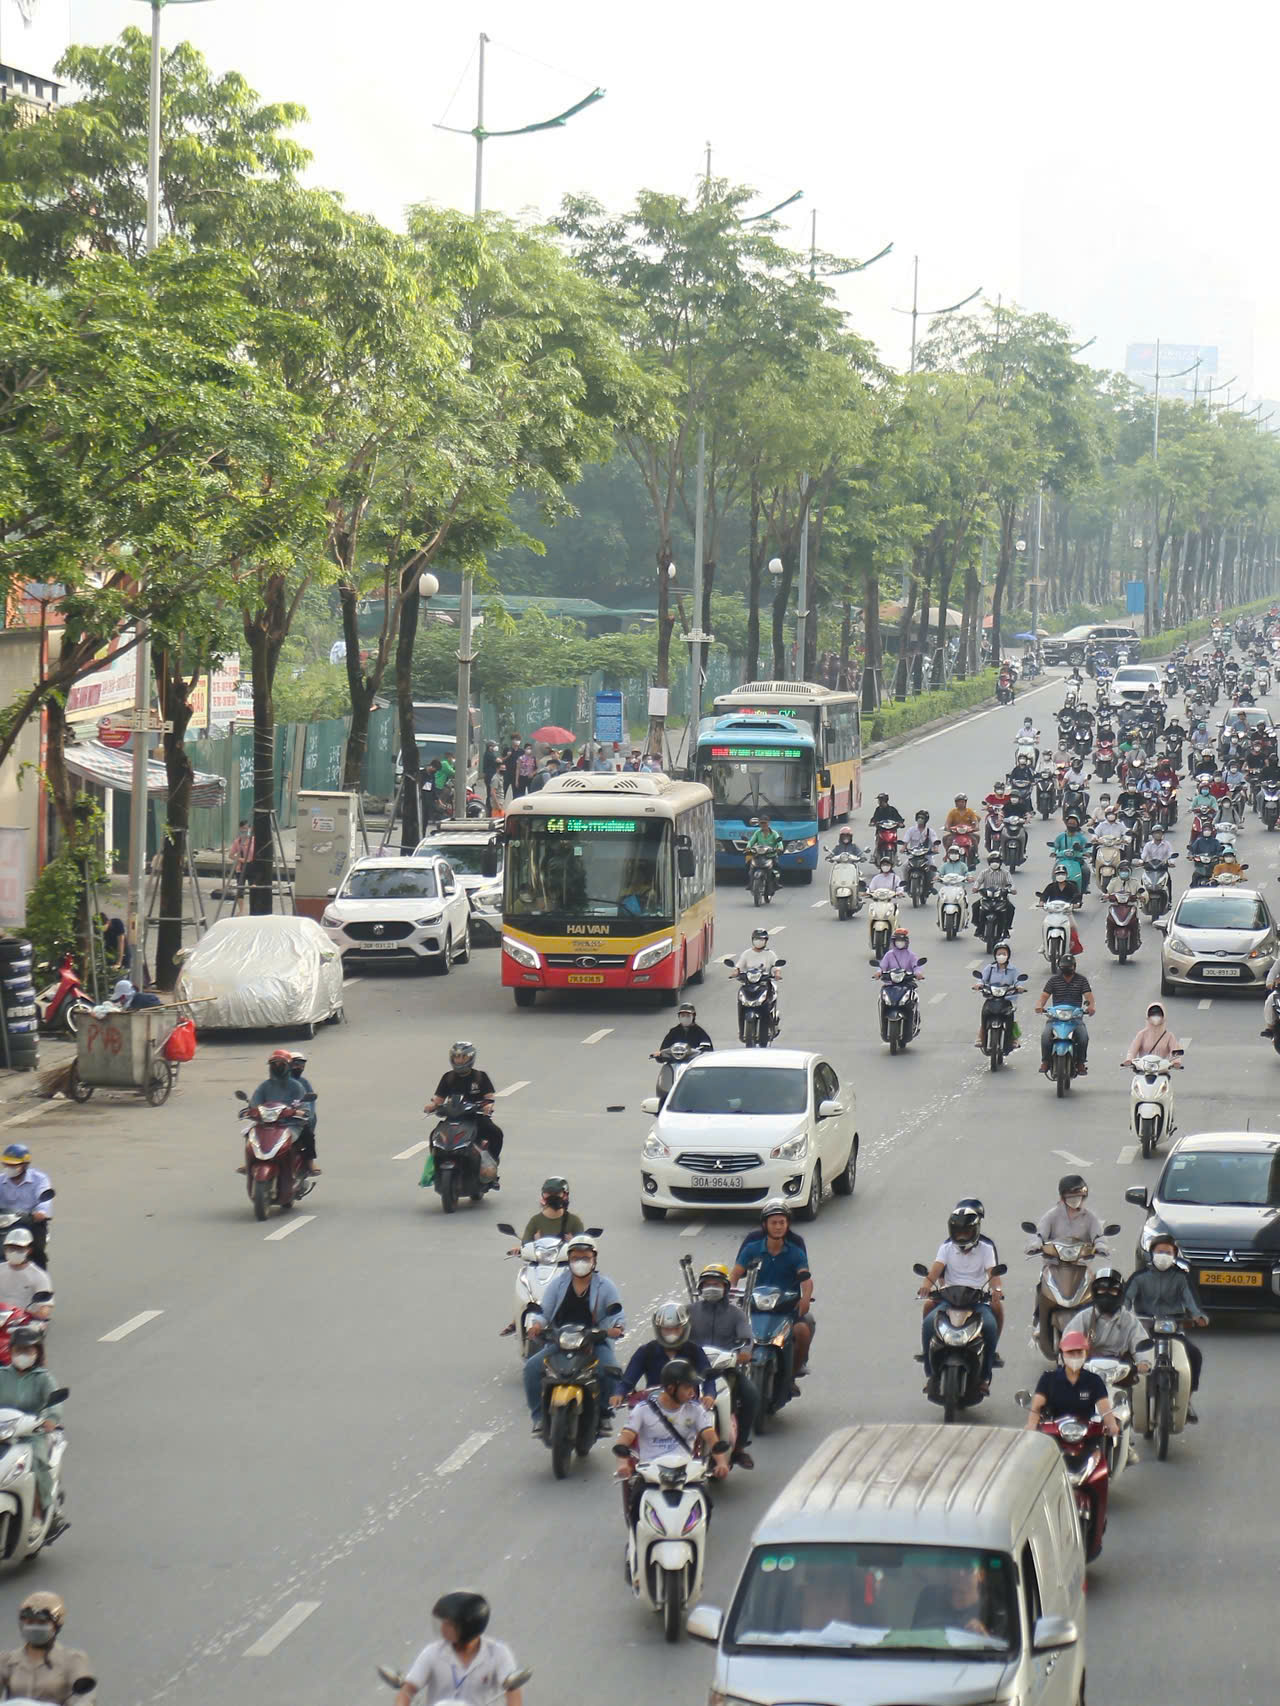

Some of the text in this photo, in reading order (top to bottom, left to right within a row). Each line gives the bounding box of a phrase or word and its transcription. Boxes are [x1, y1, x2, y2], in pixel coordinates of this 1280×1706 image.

[547, 818, 565, 833] 64
[567, 925, 609, 934] HAI VAN
[693, 1177, 741, 1188] 30A-964.43
[1206, 1273, 1257, 1284] 29E-340.78
